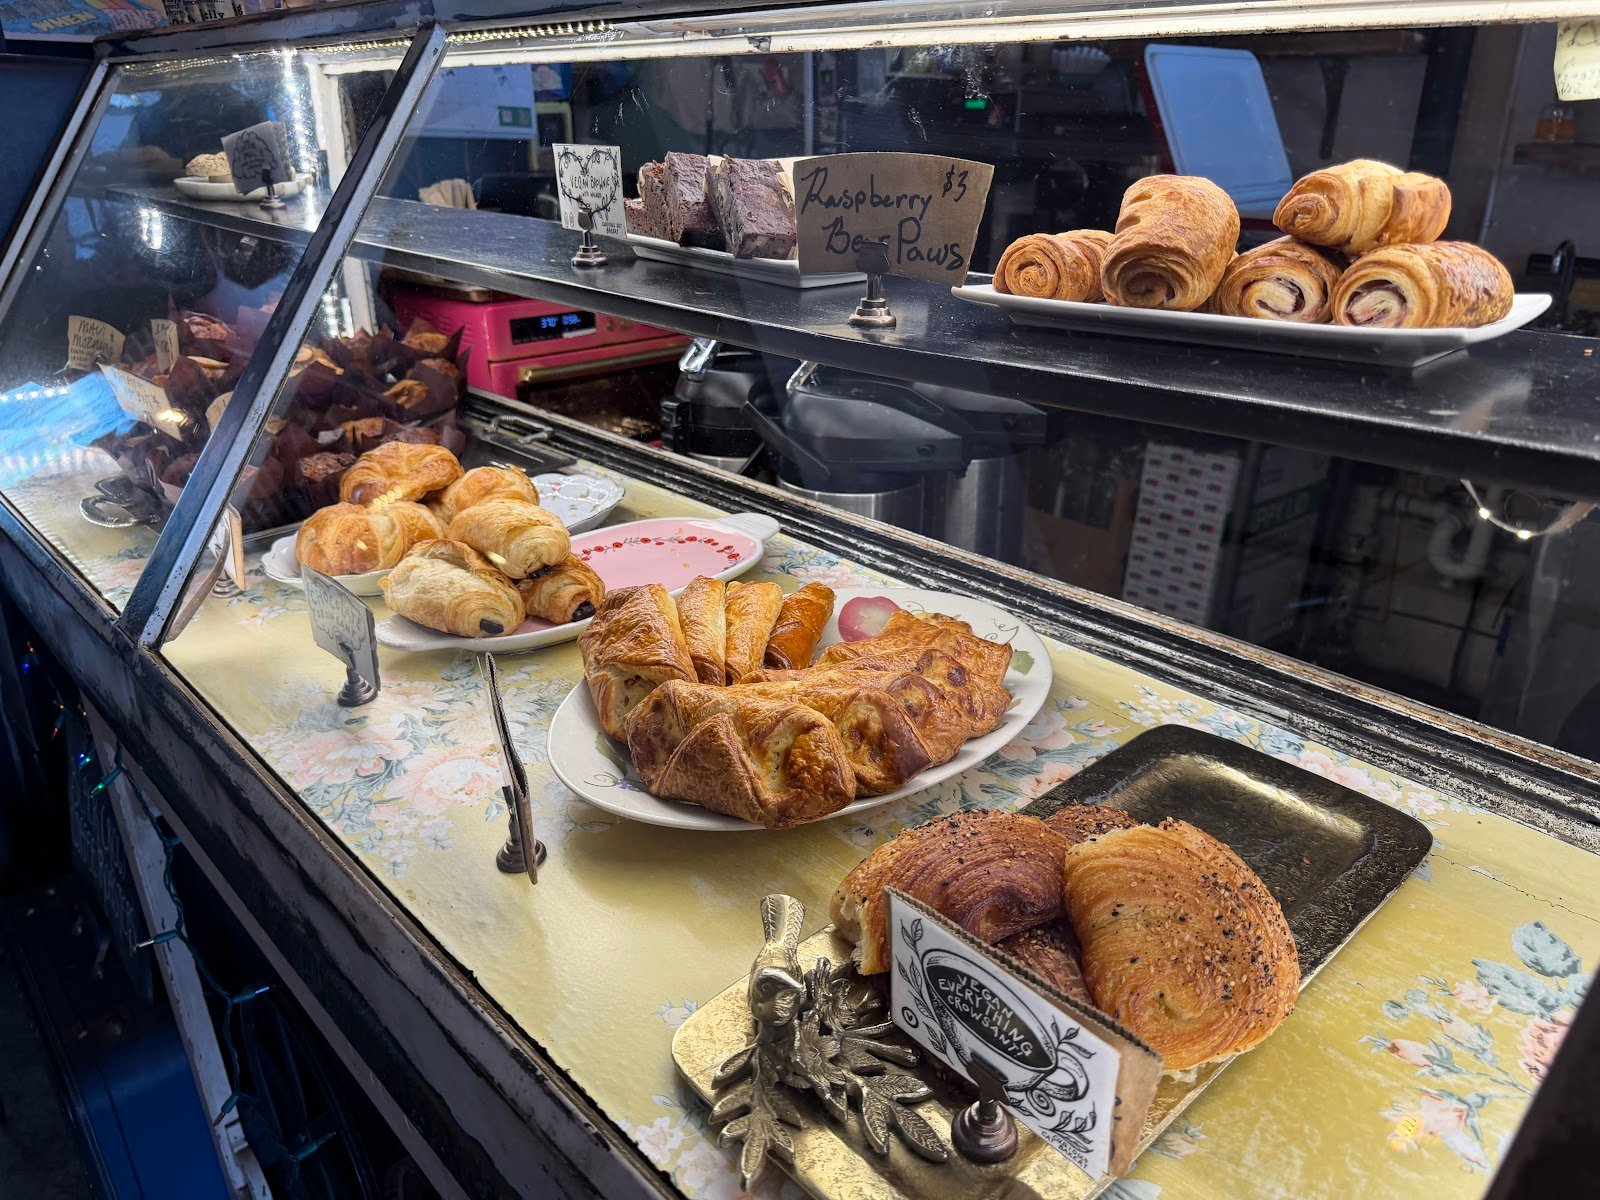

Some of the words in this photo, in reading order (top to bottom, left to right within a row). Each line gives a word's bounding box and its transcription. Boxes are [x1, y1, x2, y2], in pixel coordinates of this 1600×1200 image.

[801, 166, 932, 222] Raspberry
[942, 164, 969, 203] $3
[822, 216, 891, 255] Ber
[897, 216, 964, 270] Paws
[957, 974, 1013, 1019] VEGAN
